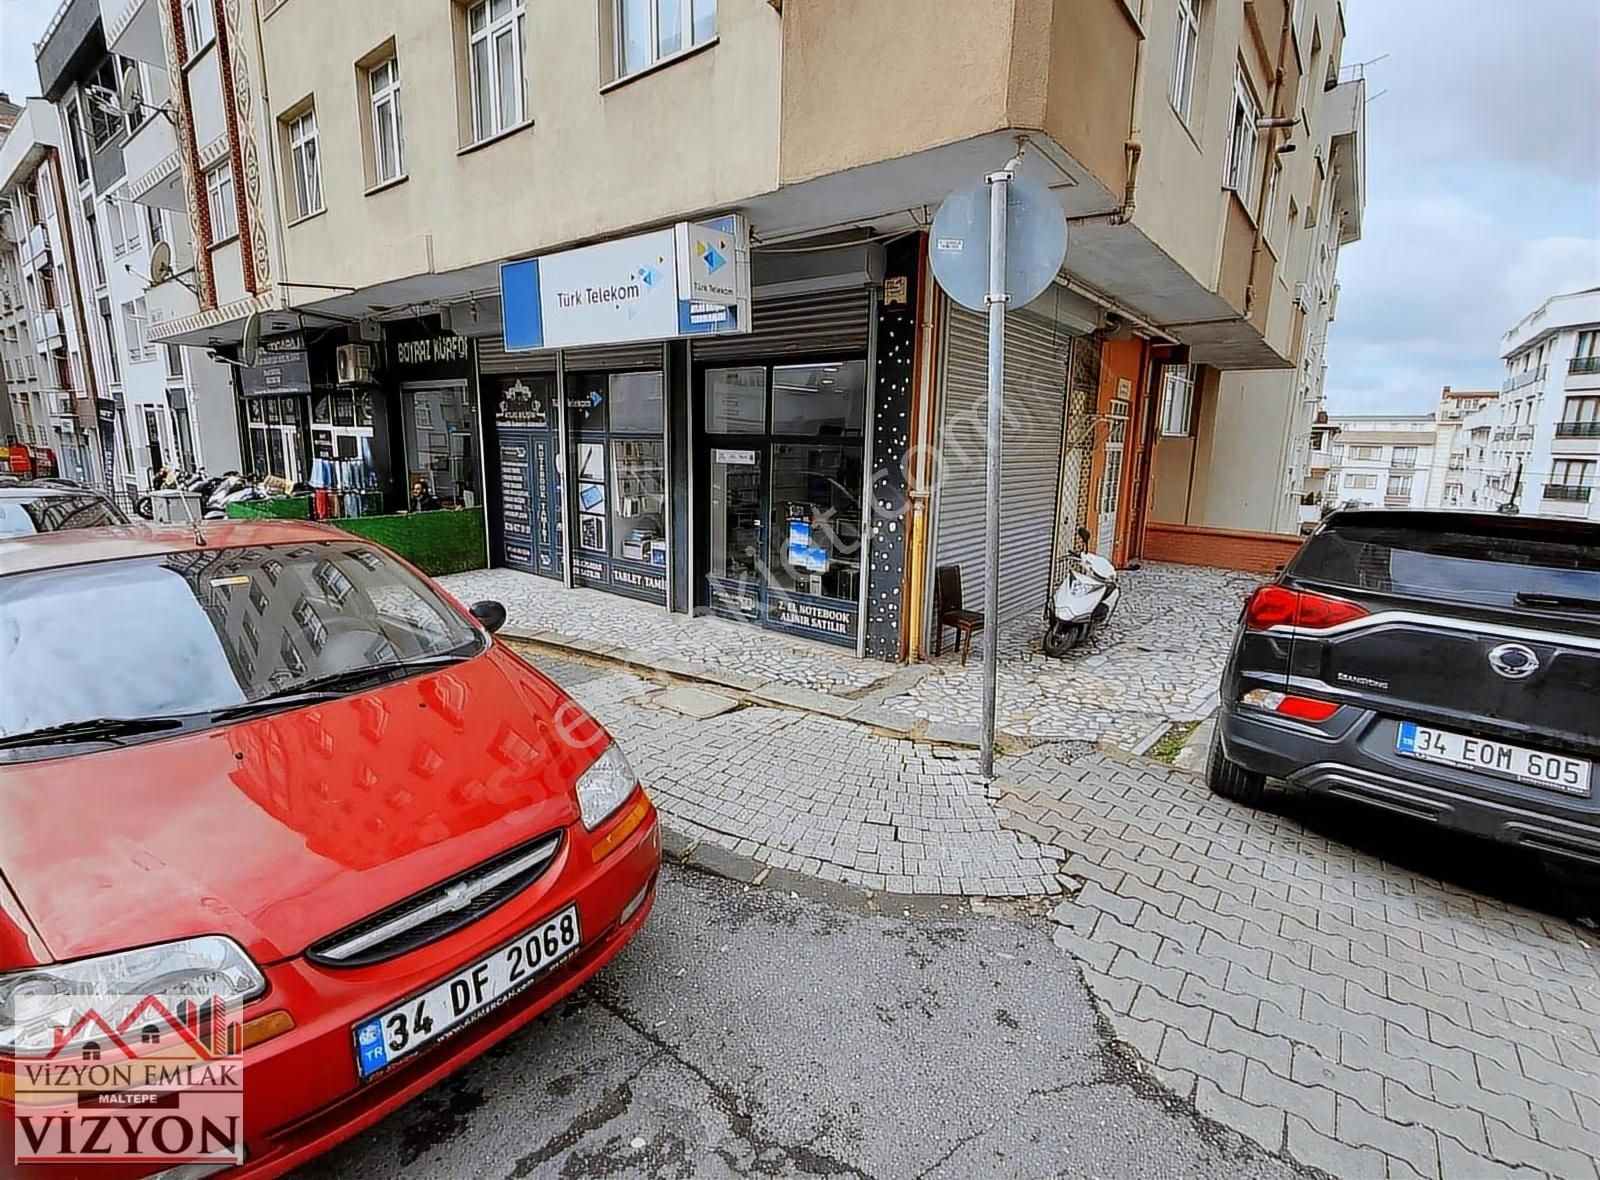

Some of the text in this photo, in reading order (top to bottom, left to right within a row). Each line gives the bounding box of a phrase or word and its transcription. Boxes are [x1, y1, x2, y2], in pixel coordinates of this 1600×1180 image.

[557, 283, 640, 308] Türk Telekom
[613, 570, 642, 585] TABLET
[778, 600, 850, 624] 2. EL NOTEBOOK
[780, 612, 847, 634] ALINIR SATILIR
[1418, 730, 1447, 755] 34
[1463, 740, 1513, 770] EOM
[1528, 754, 1581, 784] 605
[386, 1000, 434, 1052] 34
[450, 963, 489, 1017] DF
[506, 914, 575, 982] 2068
[364, 1046, 383, 1062] TR
